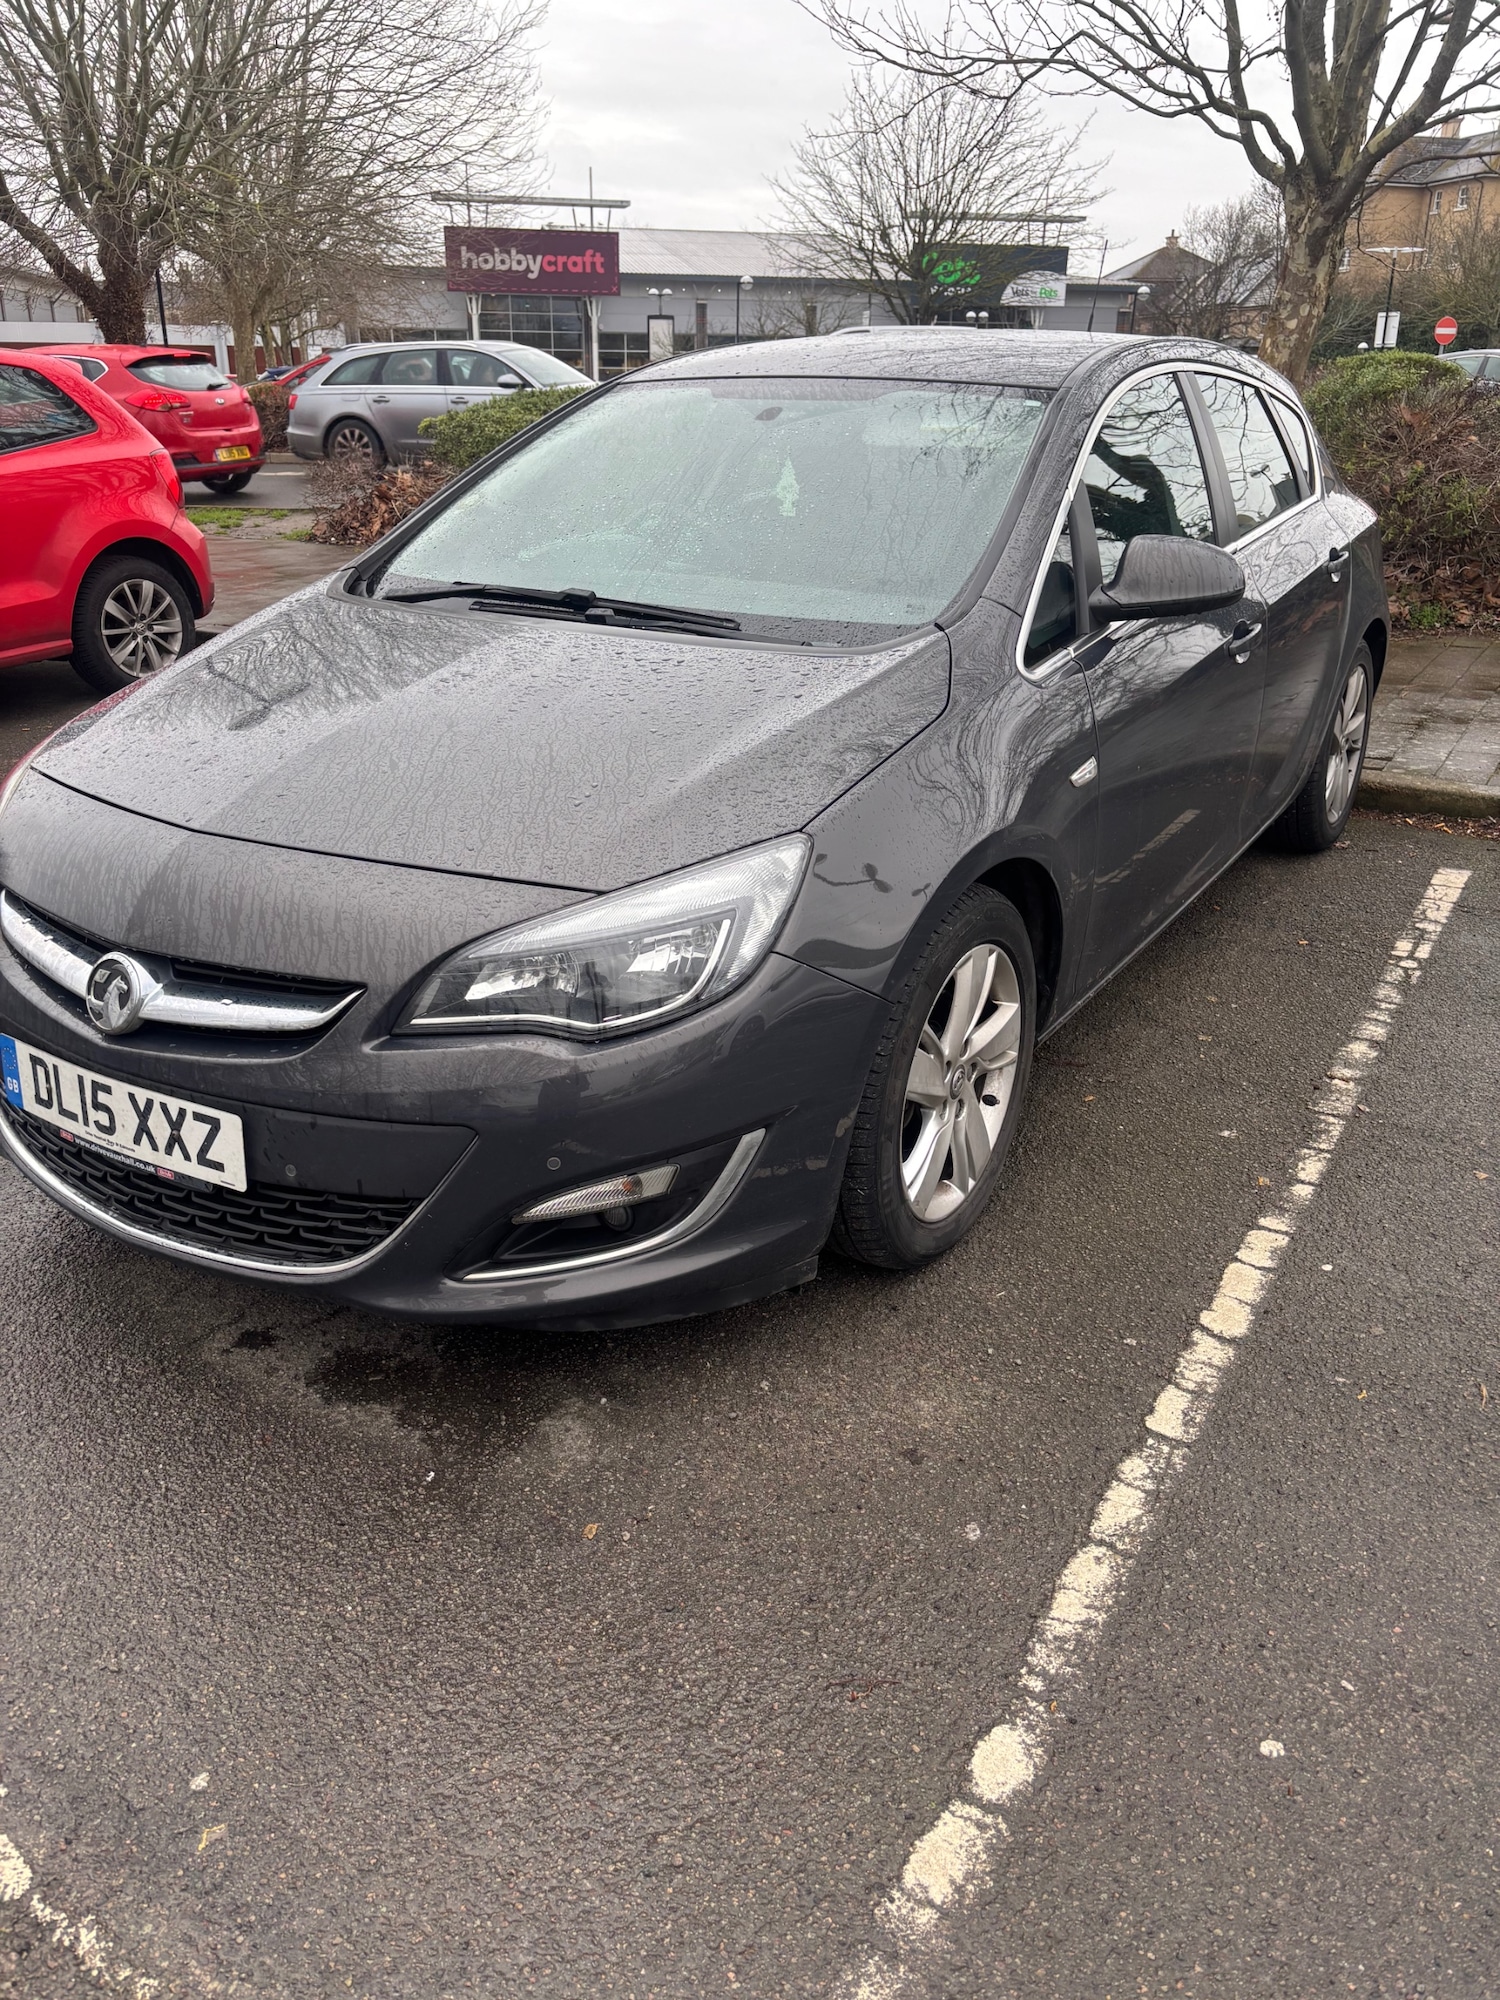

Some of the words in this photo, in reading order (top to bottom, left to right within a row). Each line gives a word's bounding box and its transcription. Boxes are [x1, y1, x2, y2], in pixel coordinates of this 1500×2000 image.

[461, 245, 604, 279] hobbycraft
[1039, 287, 1058, 298] Pets
[6, 1076, 19, 1093] GB
[29, 1054, 116, 1136] DL15
[128, 1091, 225, 1173] XXZ
[74, 1138, 156, 1174] www.drivevauxhall.co.uk
